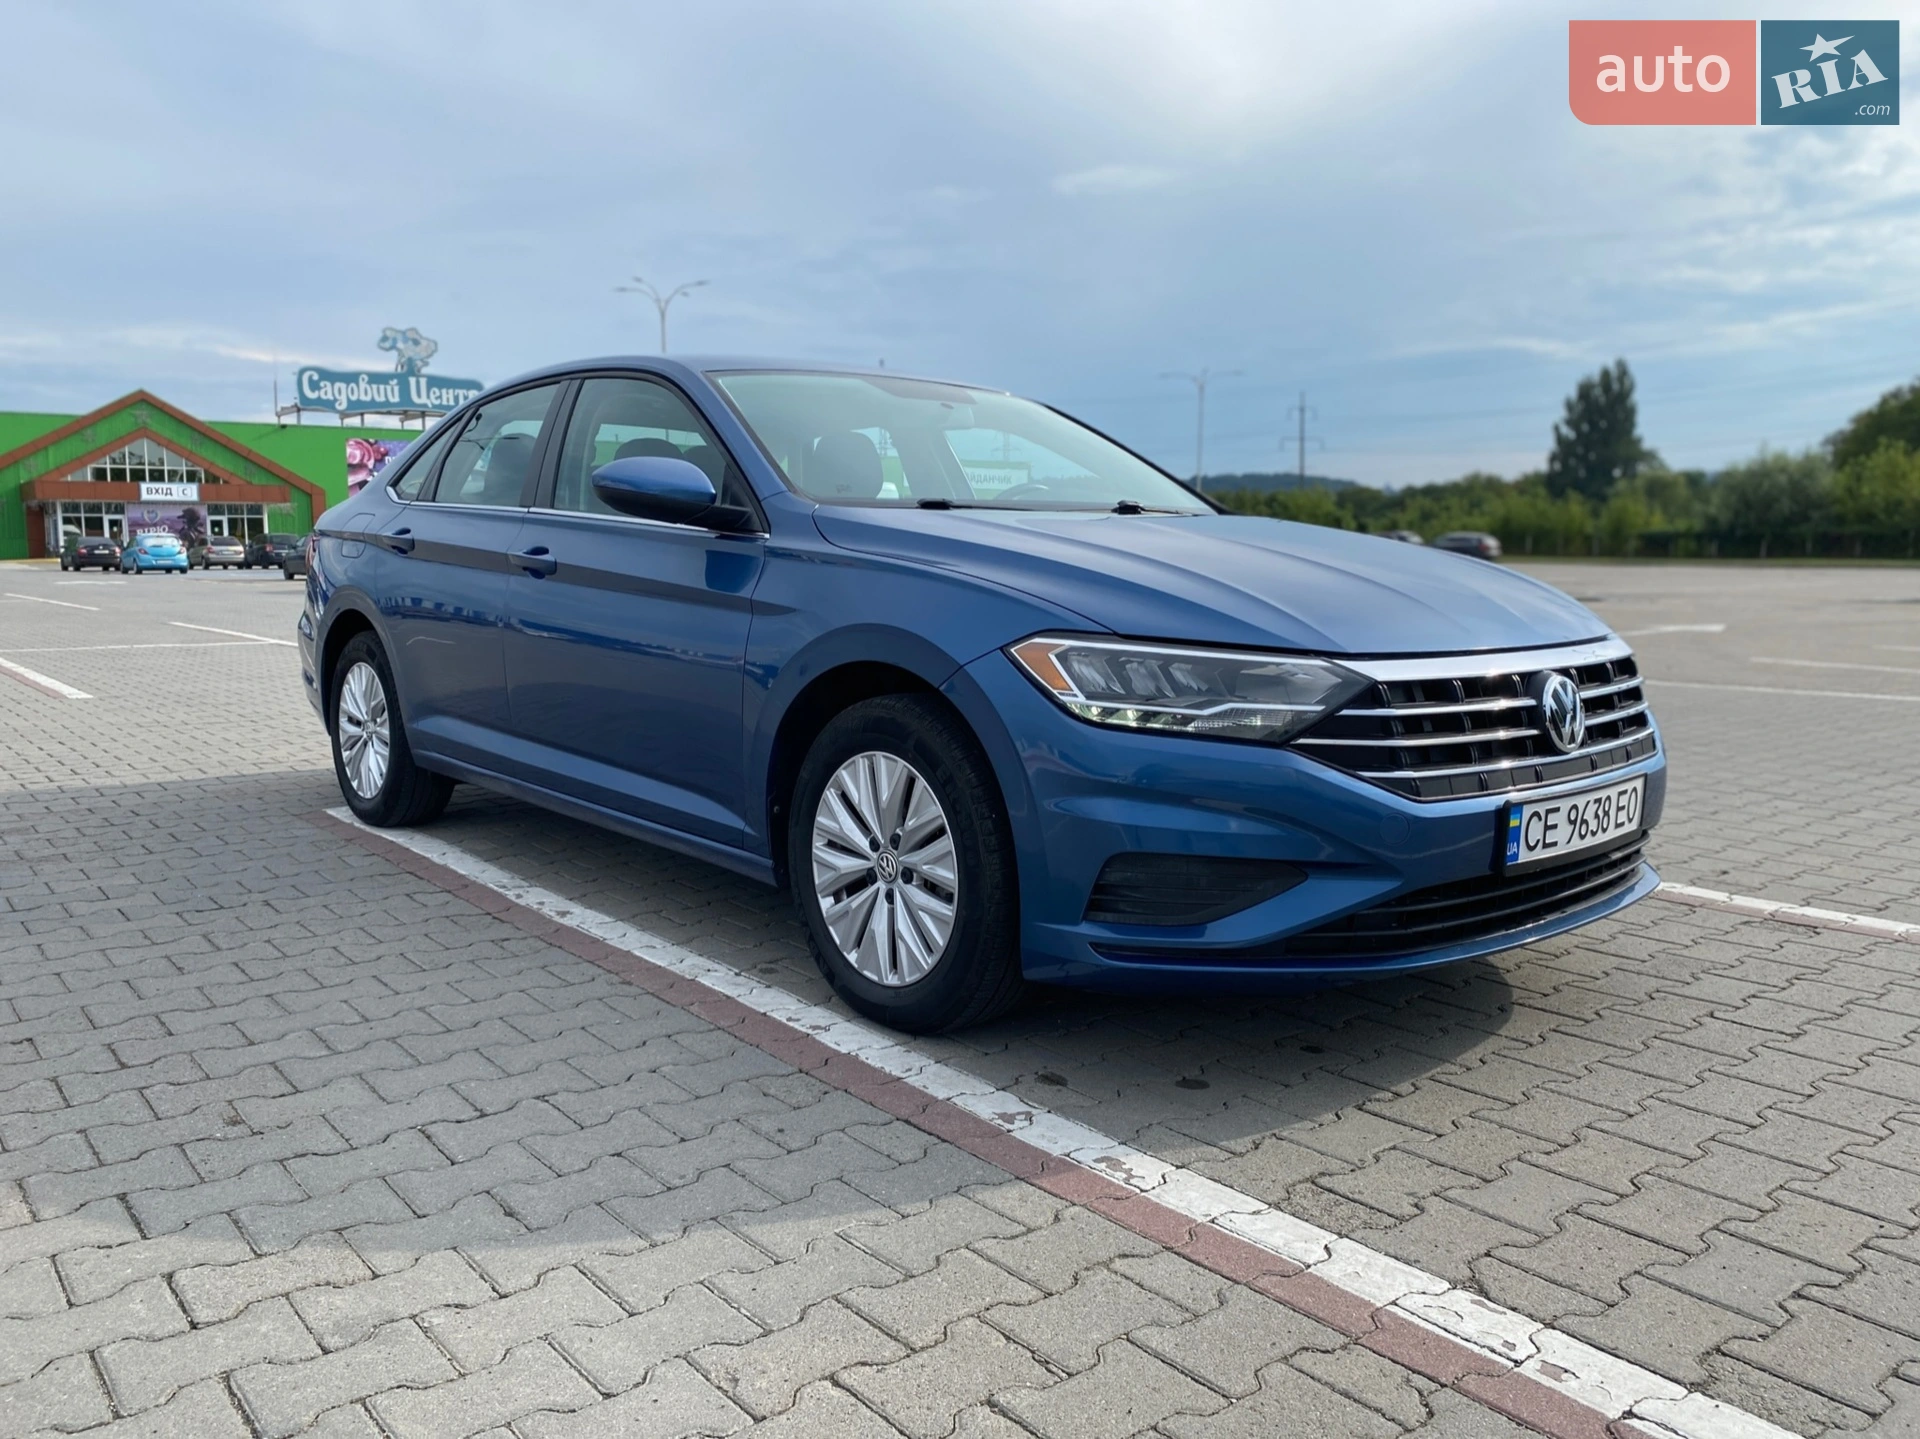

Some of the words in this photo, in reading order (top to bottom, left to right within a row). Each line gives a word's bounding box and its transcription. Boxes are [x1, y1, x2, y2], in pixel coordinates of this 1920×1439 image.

[302, 370, 400, 410] Садовий
[146, 487, 173, 496] ВХІД
[1525, 807, 1561, 852] CE
[1566, 794, 1612, 845] 9638
[1615, 786, 1638, 830] EO
[1506, 842, 1518, 856] UA
